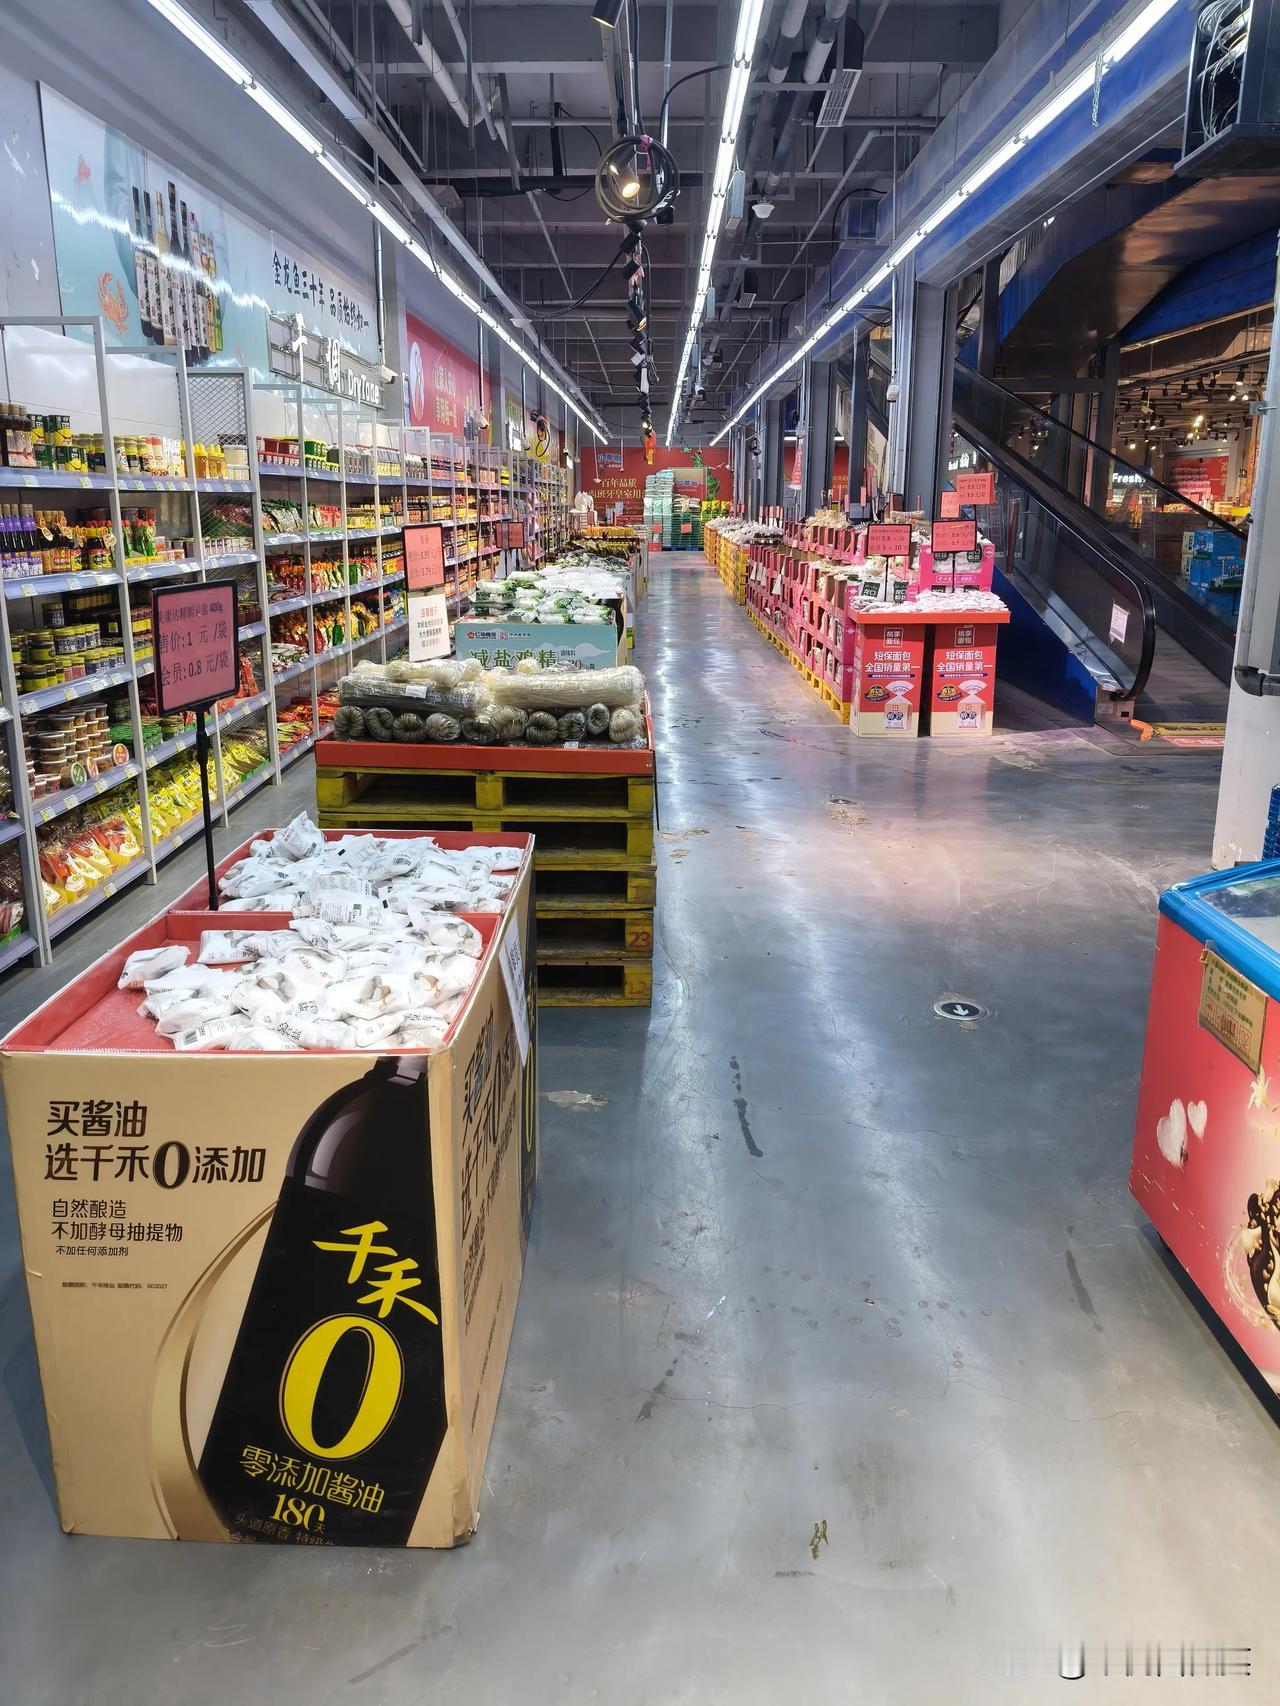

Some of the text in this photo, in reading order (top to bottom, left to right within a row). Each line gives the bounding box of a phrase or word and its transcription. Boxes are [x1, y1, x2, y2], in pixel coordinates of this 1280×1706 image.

[874, 651, 911, 661] 短保面包
[946, 650, 983, 660] 短保面包
[865, 662, 920, 672] 全国销量第一
[937, 661, 993, 672] 全国销量第一
[629, 931, 650, 948] 23
[47, 1100, 148, 1137] 买酱油
[44, 1141, 266, 1190] 选千禾0添加
[51, 1199, 127, 1219] 自然酿造
[51, 1222, 184, 1242] 不加酵母抽提物
[55, 1245, 129, 1257] 不加任何添加剂
[312, 1220, 438, 1325] 千禾
[281, 1314, 404, 1460] 0
[239, 1444, 385, 1513] 零添加酱油
